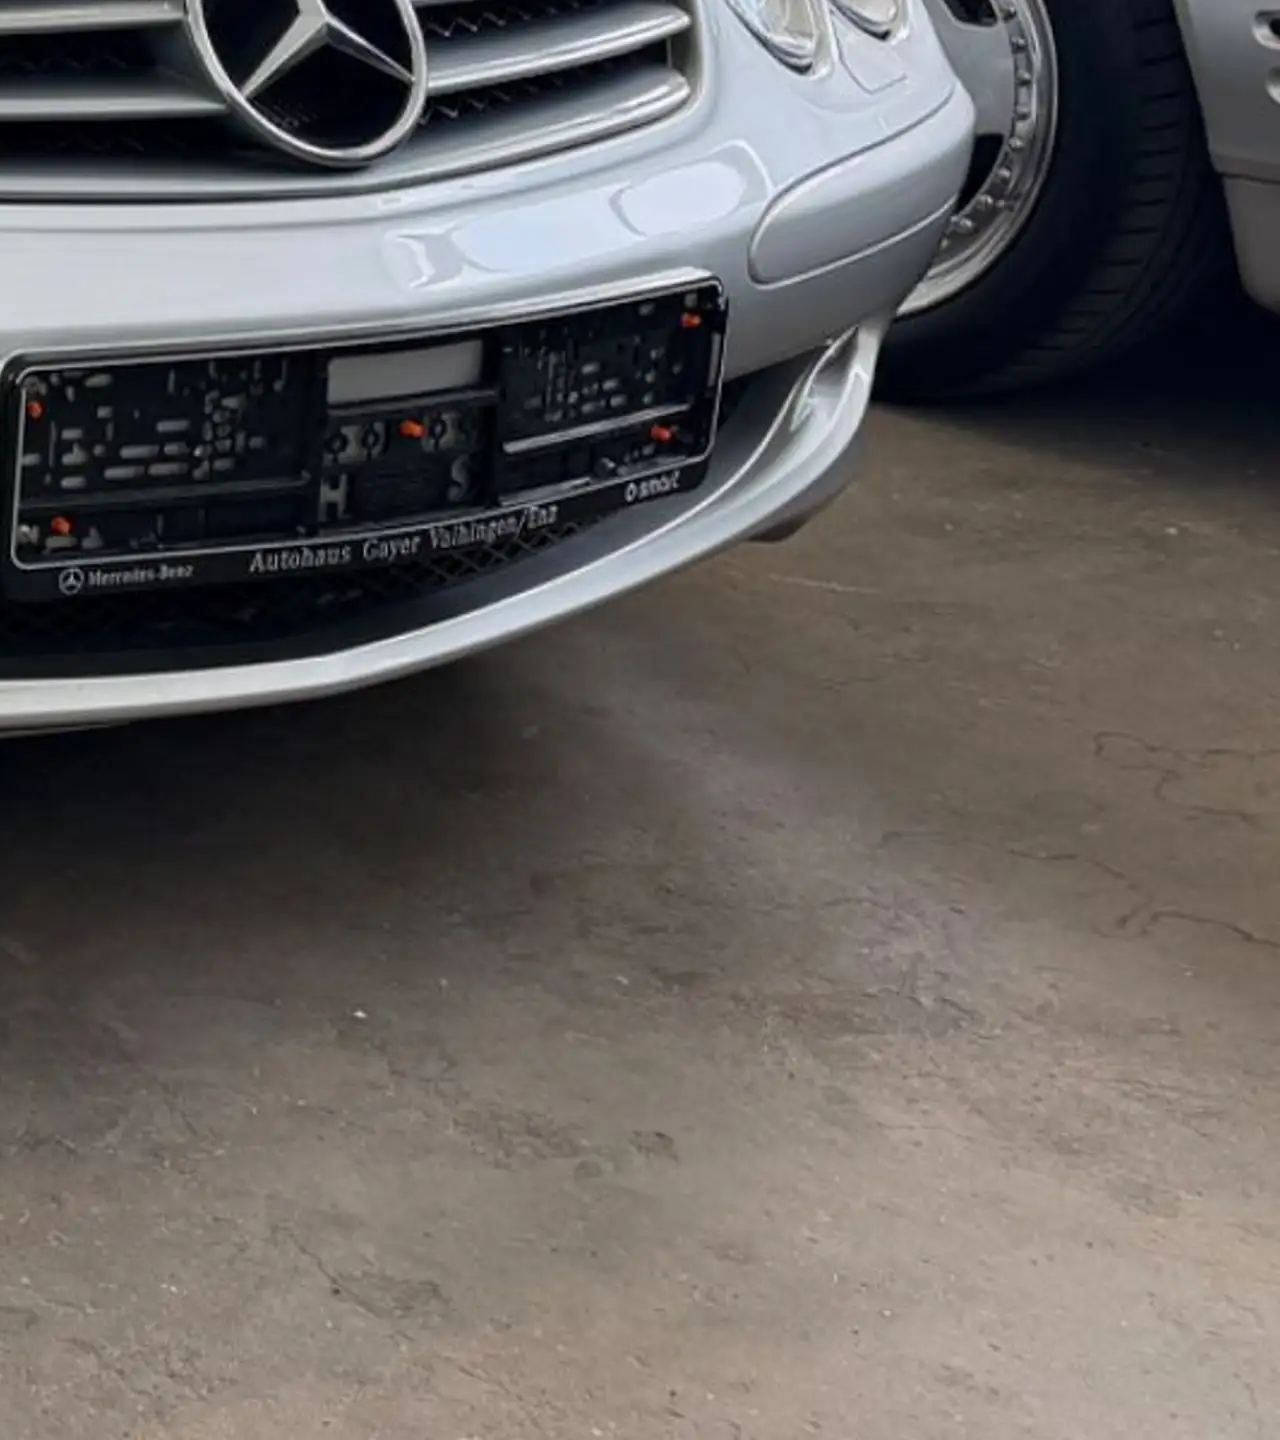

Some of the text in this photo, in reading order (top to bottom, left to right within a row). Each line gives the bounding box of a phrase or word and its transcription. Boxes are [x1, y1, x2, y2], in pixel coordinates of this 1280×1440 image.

[250, 546, 353, 573] Autohaus
[362, 534, 422, 561] Gayer
[88, 564, 195, 586] Mercedes-Benz
